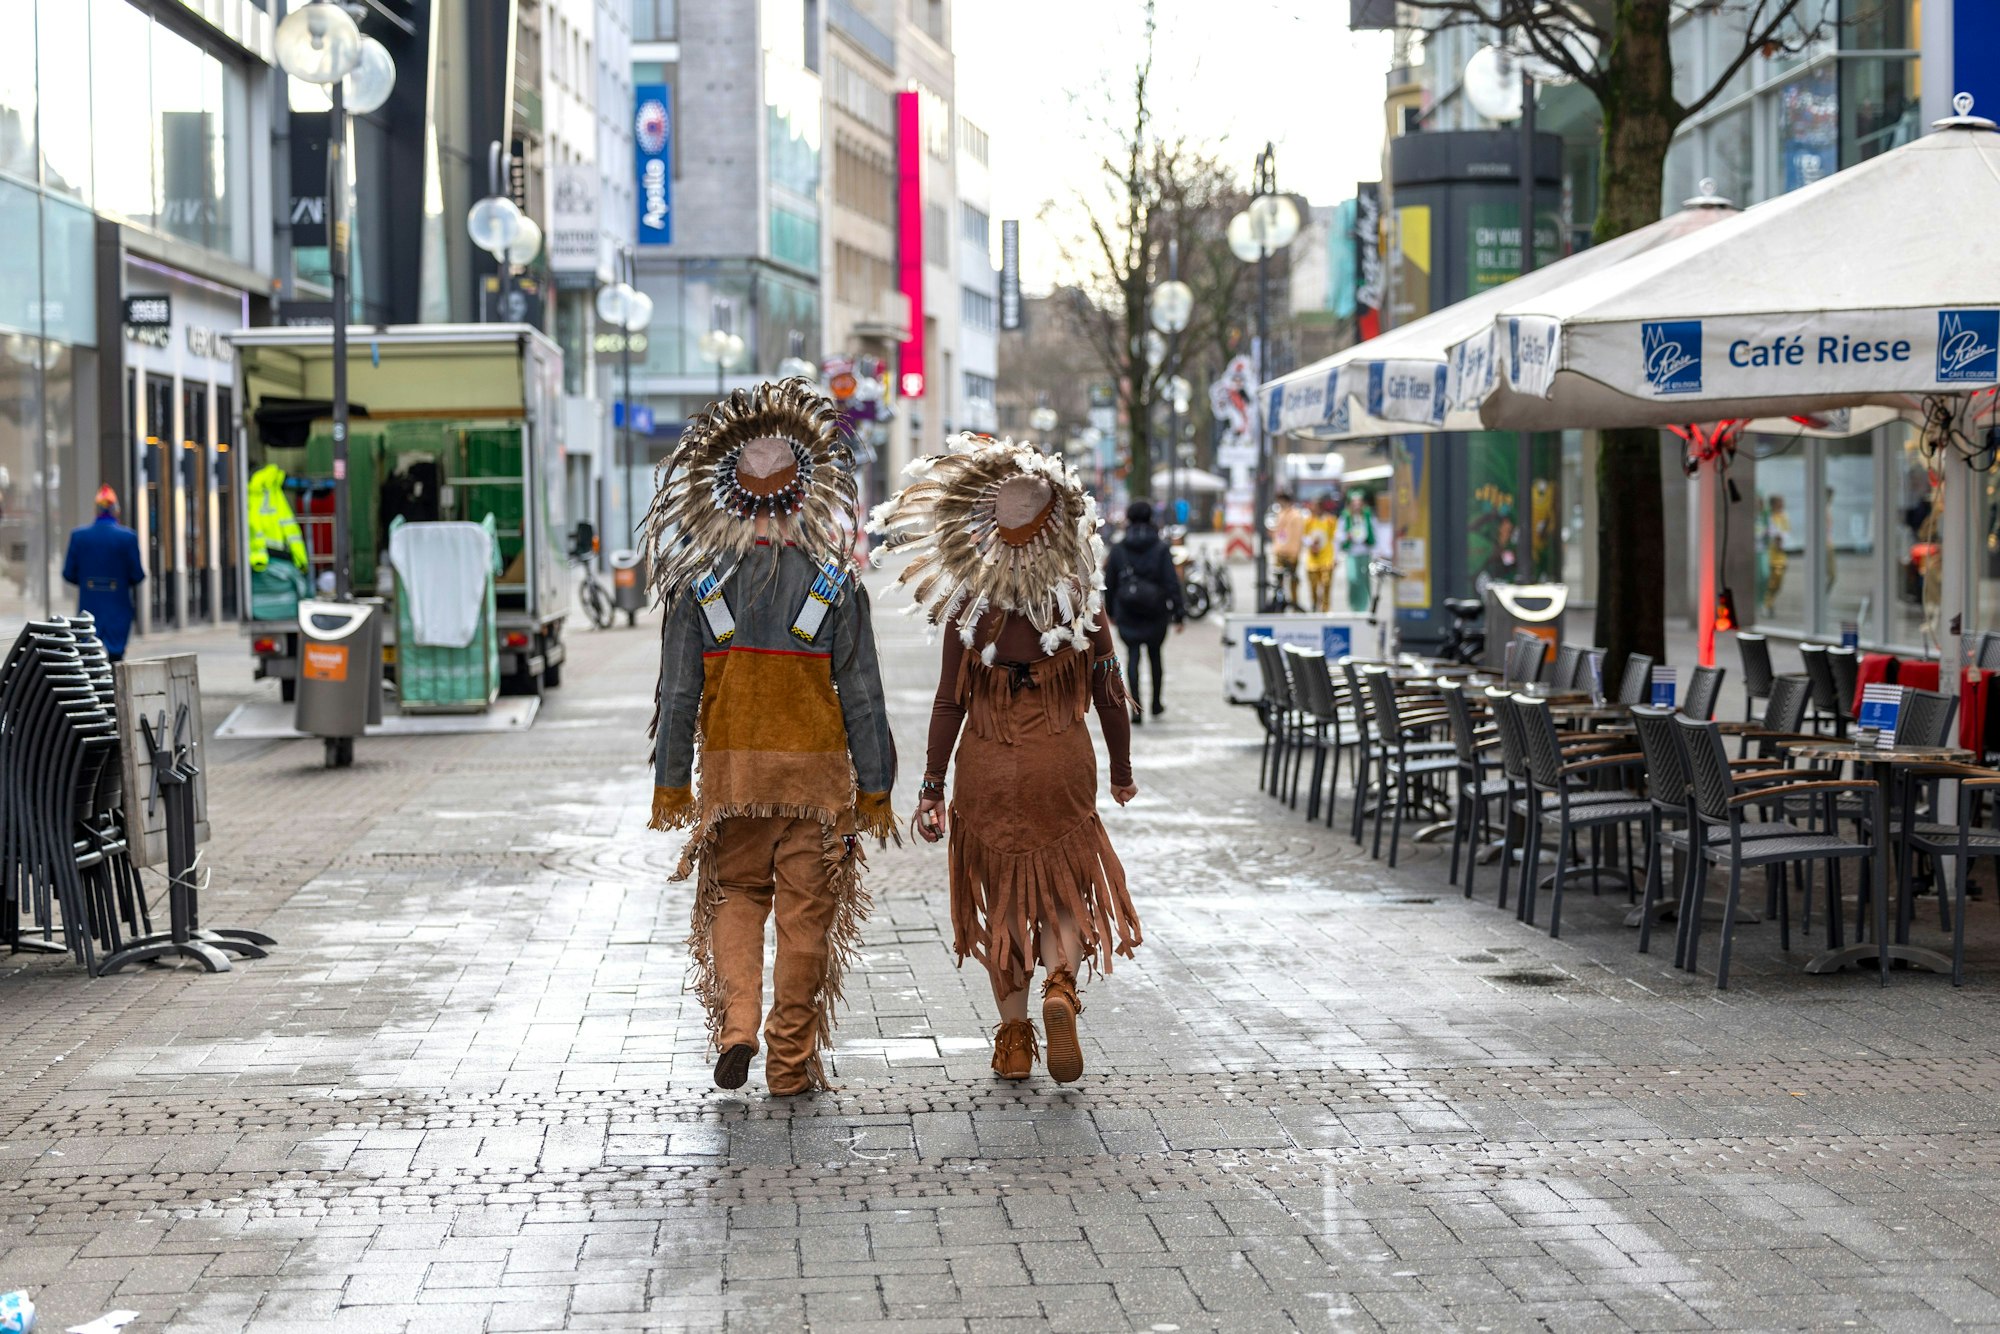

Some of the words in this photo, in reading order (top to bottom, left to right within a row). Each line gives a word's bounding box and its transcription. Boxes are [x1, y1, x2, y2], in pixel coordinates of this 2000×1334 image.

[642, 158, 669, 230] Apollo
[1728, 335, 1805, 368] Café
[1817, 334, 1912, 364] Riese
